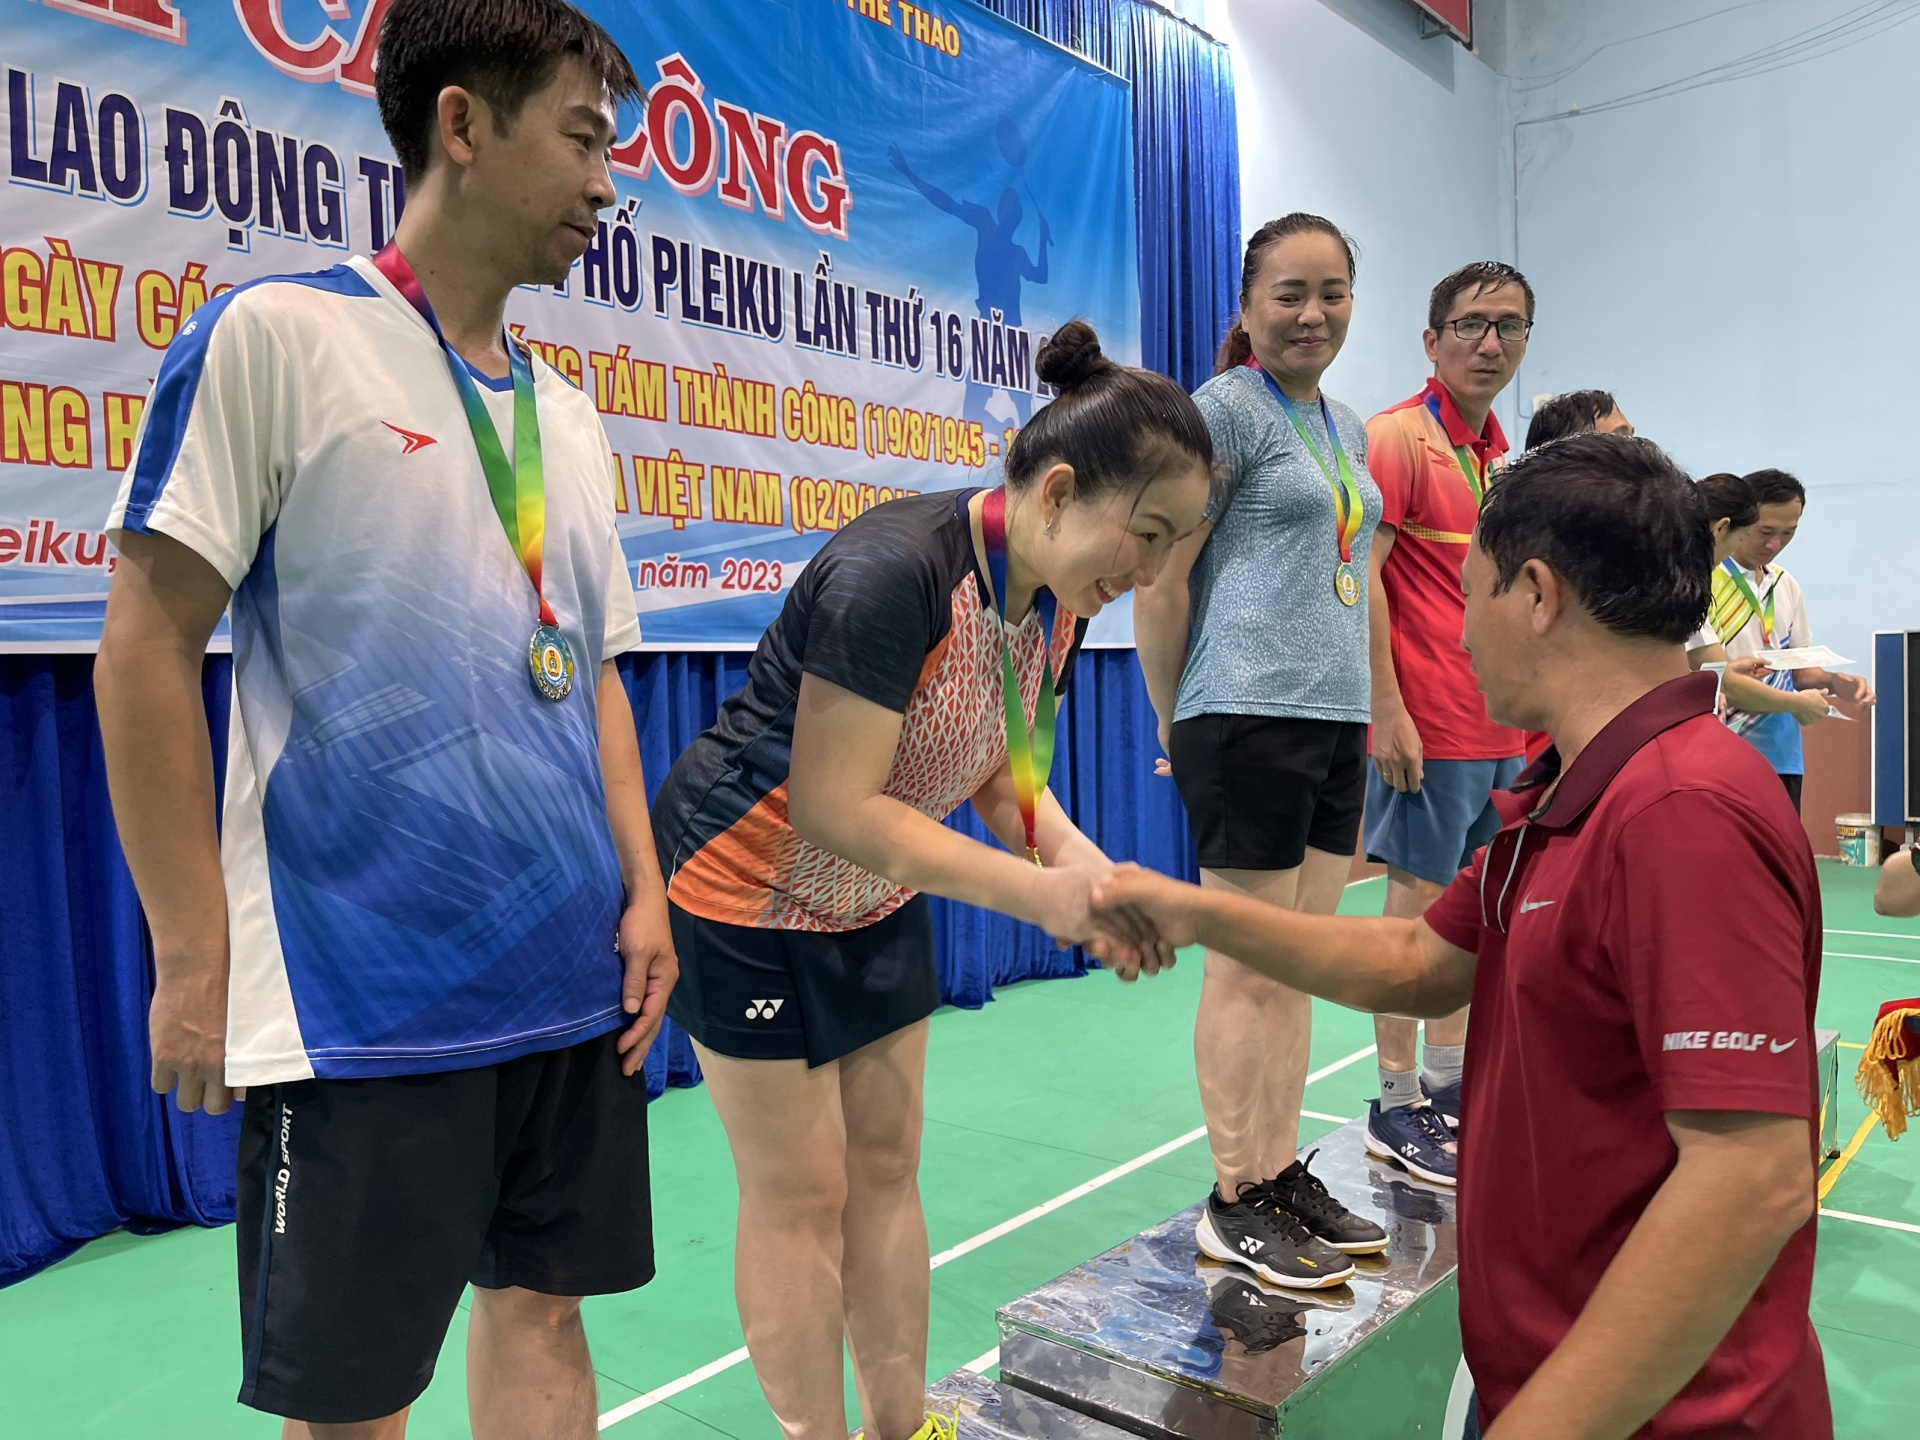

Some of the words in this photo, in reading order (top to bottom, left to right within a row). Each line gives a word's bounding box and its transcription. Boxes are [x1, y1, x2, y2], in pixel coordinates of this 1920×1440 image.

[897, 0, 961, 58] THAO
[8, 68, 141, 200] LAO
[165, 100, 345, 246] ĐỘNG
[553, 199, 640, 307] HỐ
[652, 234, 783, 340] PLEIKU
[792, 249, 858, 356] LẦN
[865, 287, 923, 369] THỨ
[930, 310, 963, 378] 16
[971, 311, 1031, 392] NĂM
[0, 237, 124, 342] GÀY
[135, 262, 236, 350] CÁ
[589, 344, 667, 422] TÁM
[673, 362, 776, 439] THÀNH
[782, 380, 857, 450] CÔNG
[863, 402, 985, 468] (19/8/1945
[632, 448, 705, 530] VIỆT
[711, 465, 783, 527] NAM
[638, 555, 709, 588] năm
[721, 559, 782, 592] 2023
[1662, 1030, 1710, 1051] NIKE
[1711, 1031, 1767, 1051] GOLF
[281, 1103, 293, 1165] SPORT
[275, 1168, 291, 1233] WORLD
